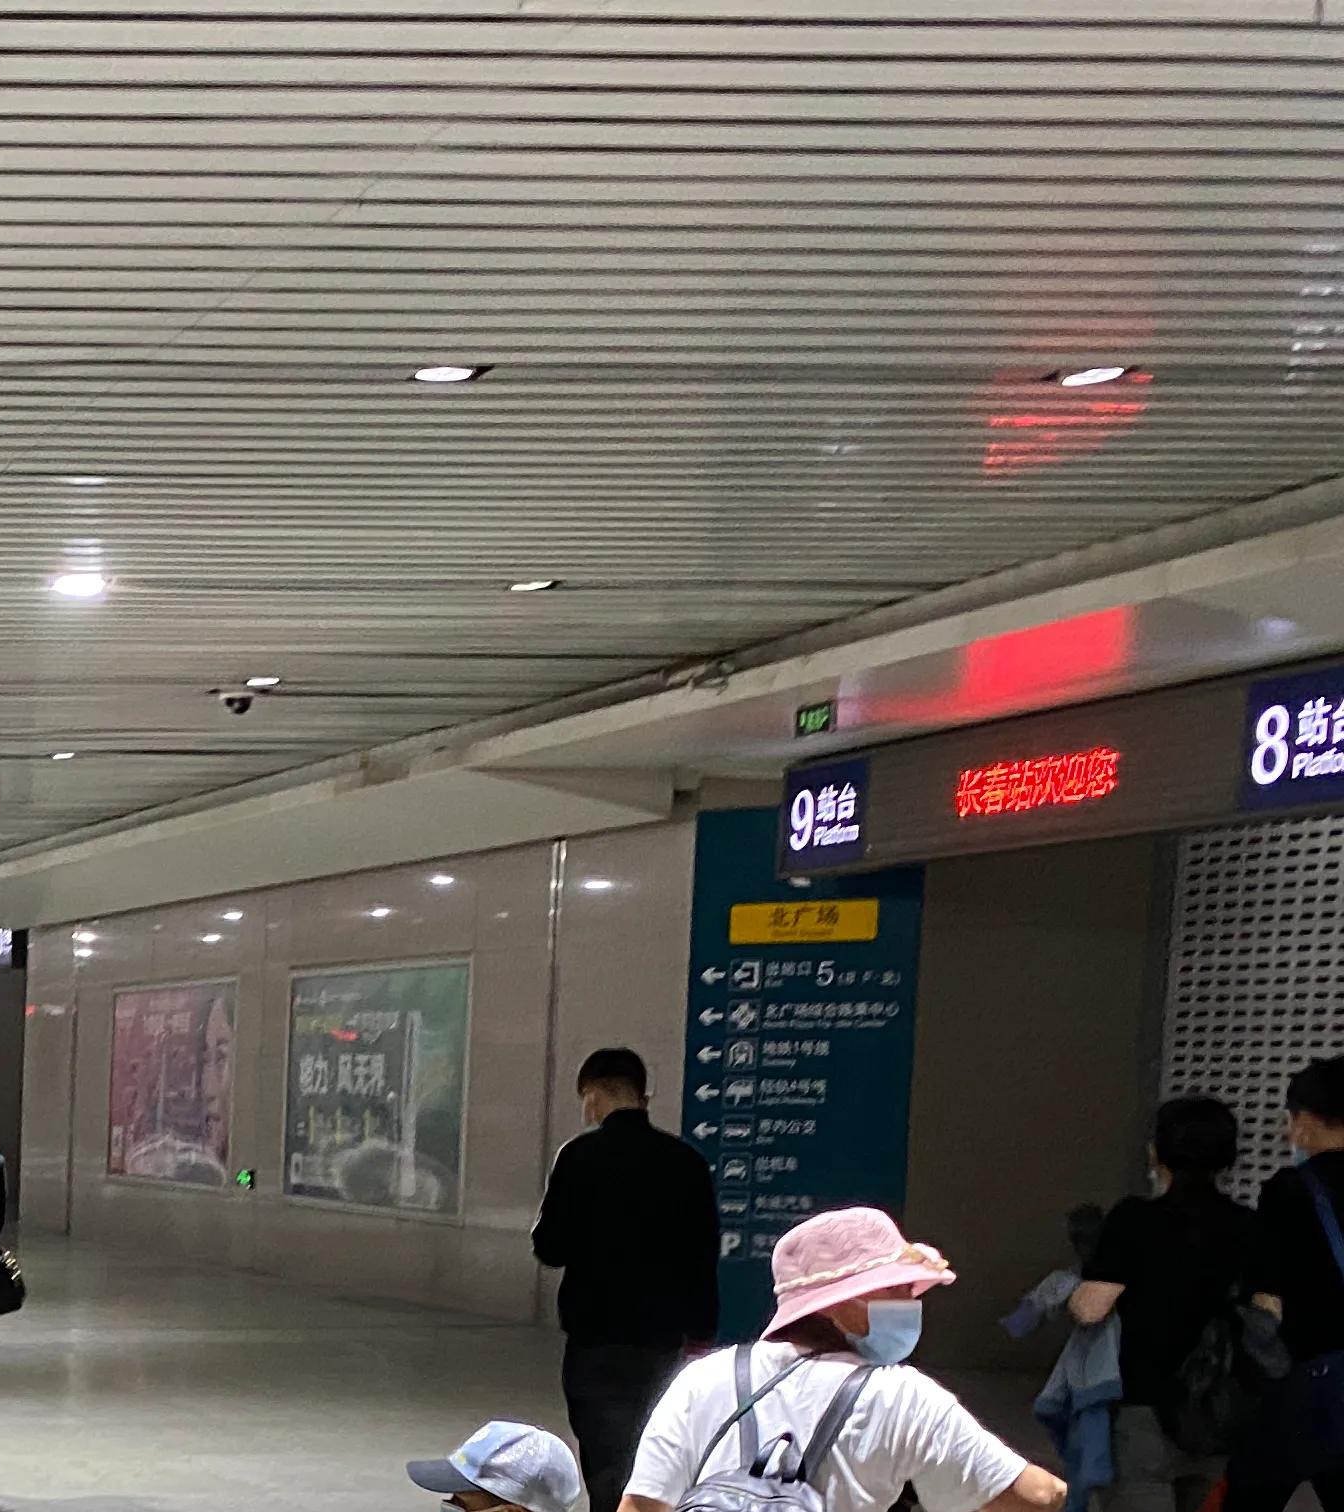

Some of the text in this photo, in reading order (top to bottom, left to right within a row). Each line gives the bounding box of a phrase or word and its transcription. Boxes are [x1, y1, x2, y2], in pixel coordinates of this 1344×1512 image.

[1252, 705, 1290, 785] 8
[816, 782, 858, 822] 站台
[958, 747, 1119, 819] 长春站欢迎您
[790, 789, 814, 851] 9
[768, 906, 840, 929] 北广场
[815, 960, 835, 987] 5
